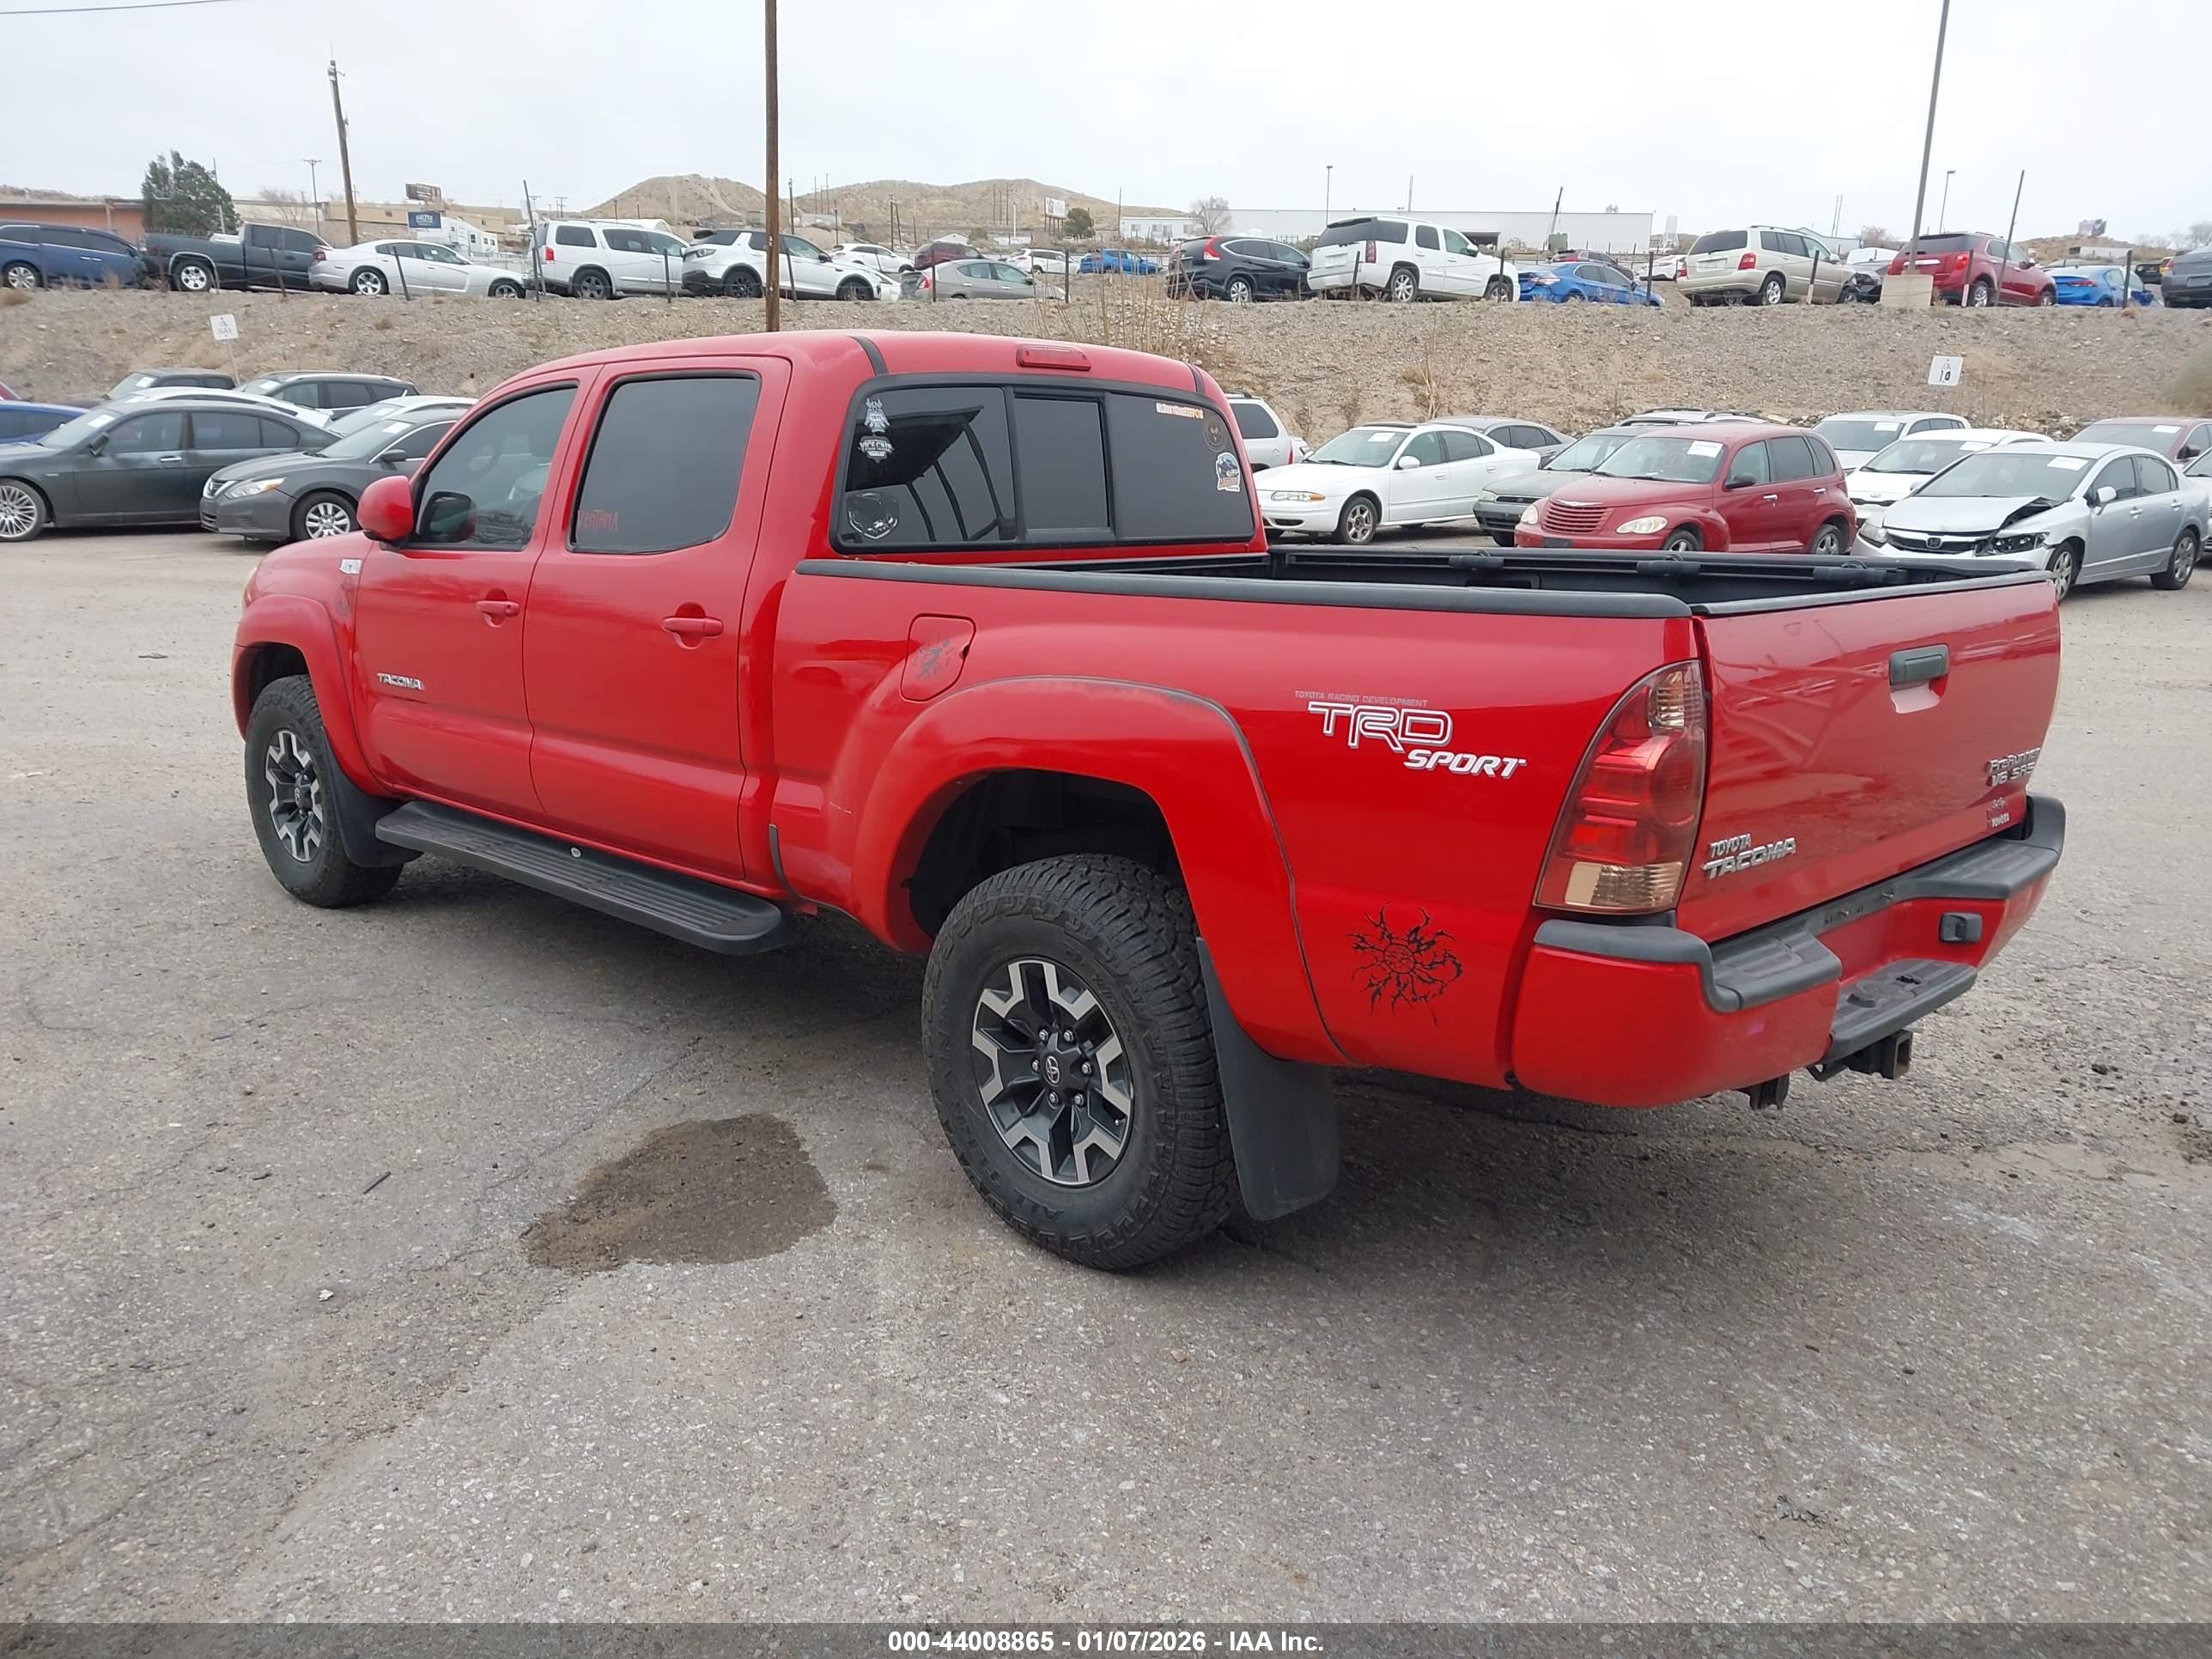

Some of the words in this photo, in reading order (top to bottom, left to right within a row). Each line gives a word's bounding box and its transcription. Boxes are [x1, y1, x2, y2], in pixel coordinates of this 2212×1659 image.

[376, 672, 423, 690] TACOMA
[1295, 690, 1325, 700] TOYOTA
[1327, 693, 1360, 702] RACING
[1362, 696, 1428, 708] DEVELOPMENT
[1308, 701, 1453, 753] TRD
[1403, 749, 1528, 780] SPORT
[1703, 837, 1796, 880] TACOMA
[1711, 833, 1752, 859] TOYOTA
